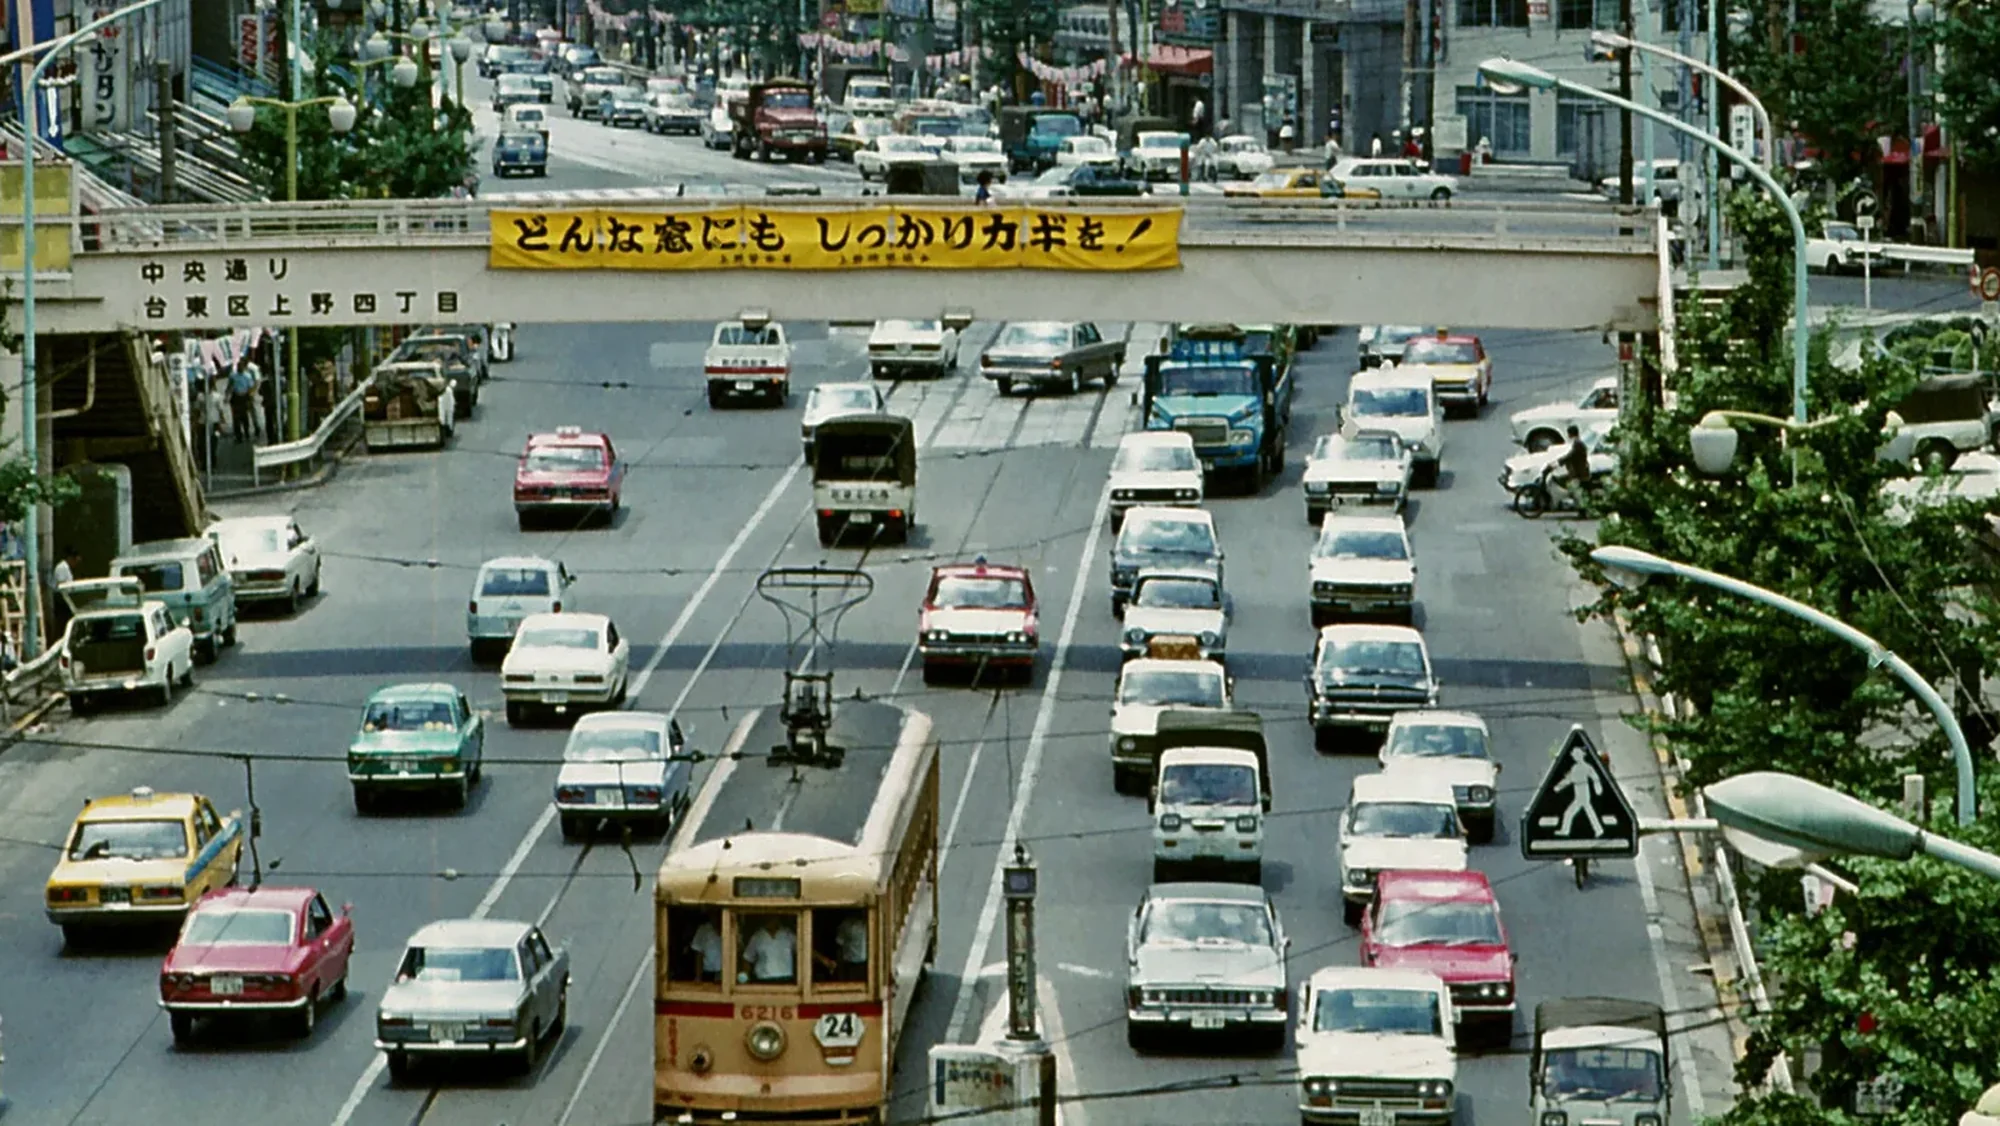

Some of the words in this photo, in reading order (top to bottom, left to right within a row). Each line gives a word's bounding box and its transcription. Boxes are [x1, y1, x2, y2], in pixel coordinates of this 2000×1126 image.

[513, 213, 786, 254] どんな窓にも
[141, 258, 289, 285] 中央通り
[144, 291, 458, 319] 台東区上野四丁目
[741, 1005, 793, 1020] 6216
[825, 1014, 853, 1037] 24
